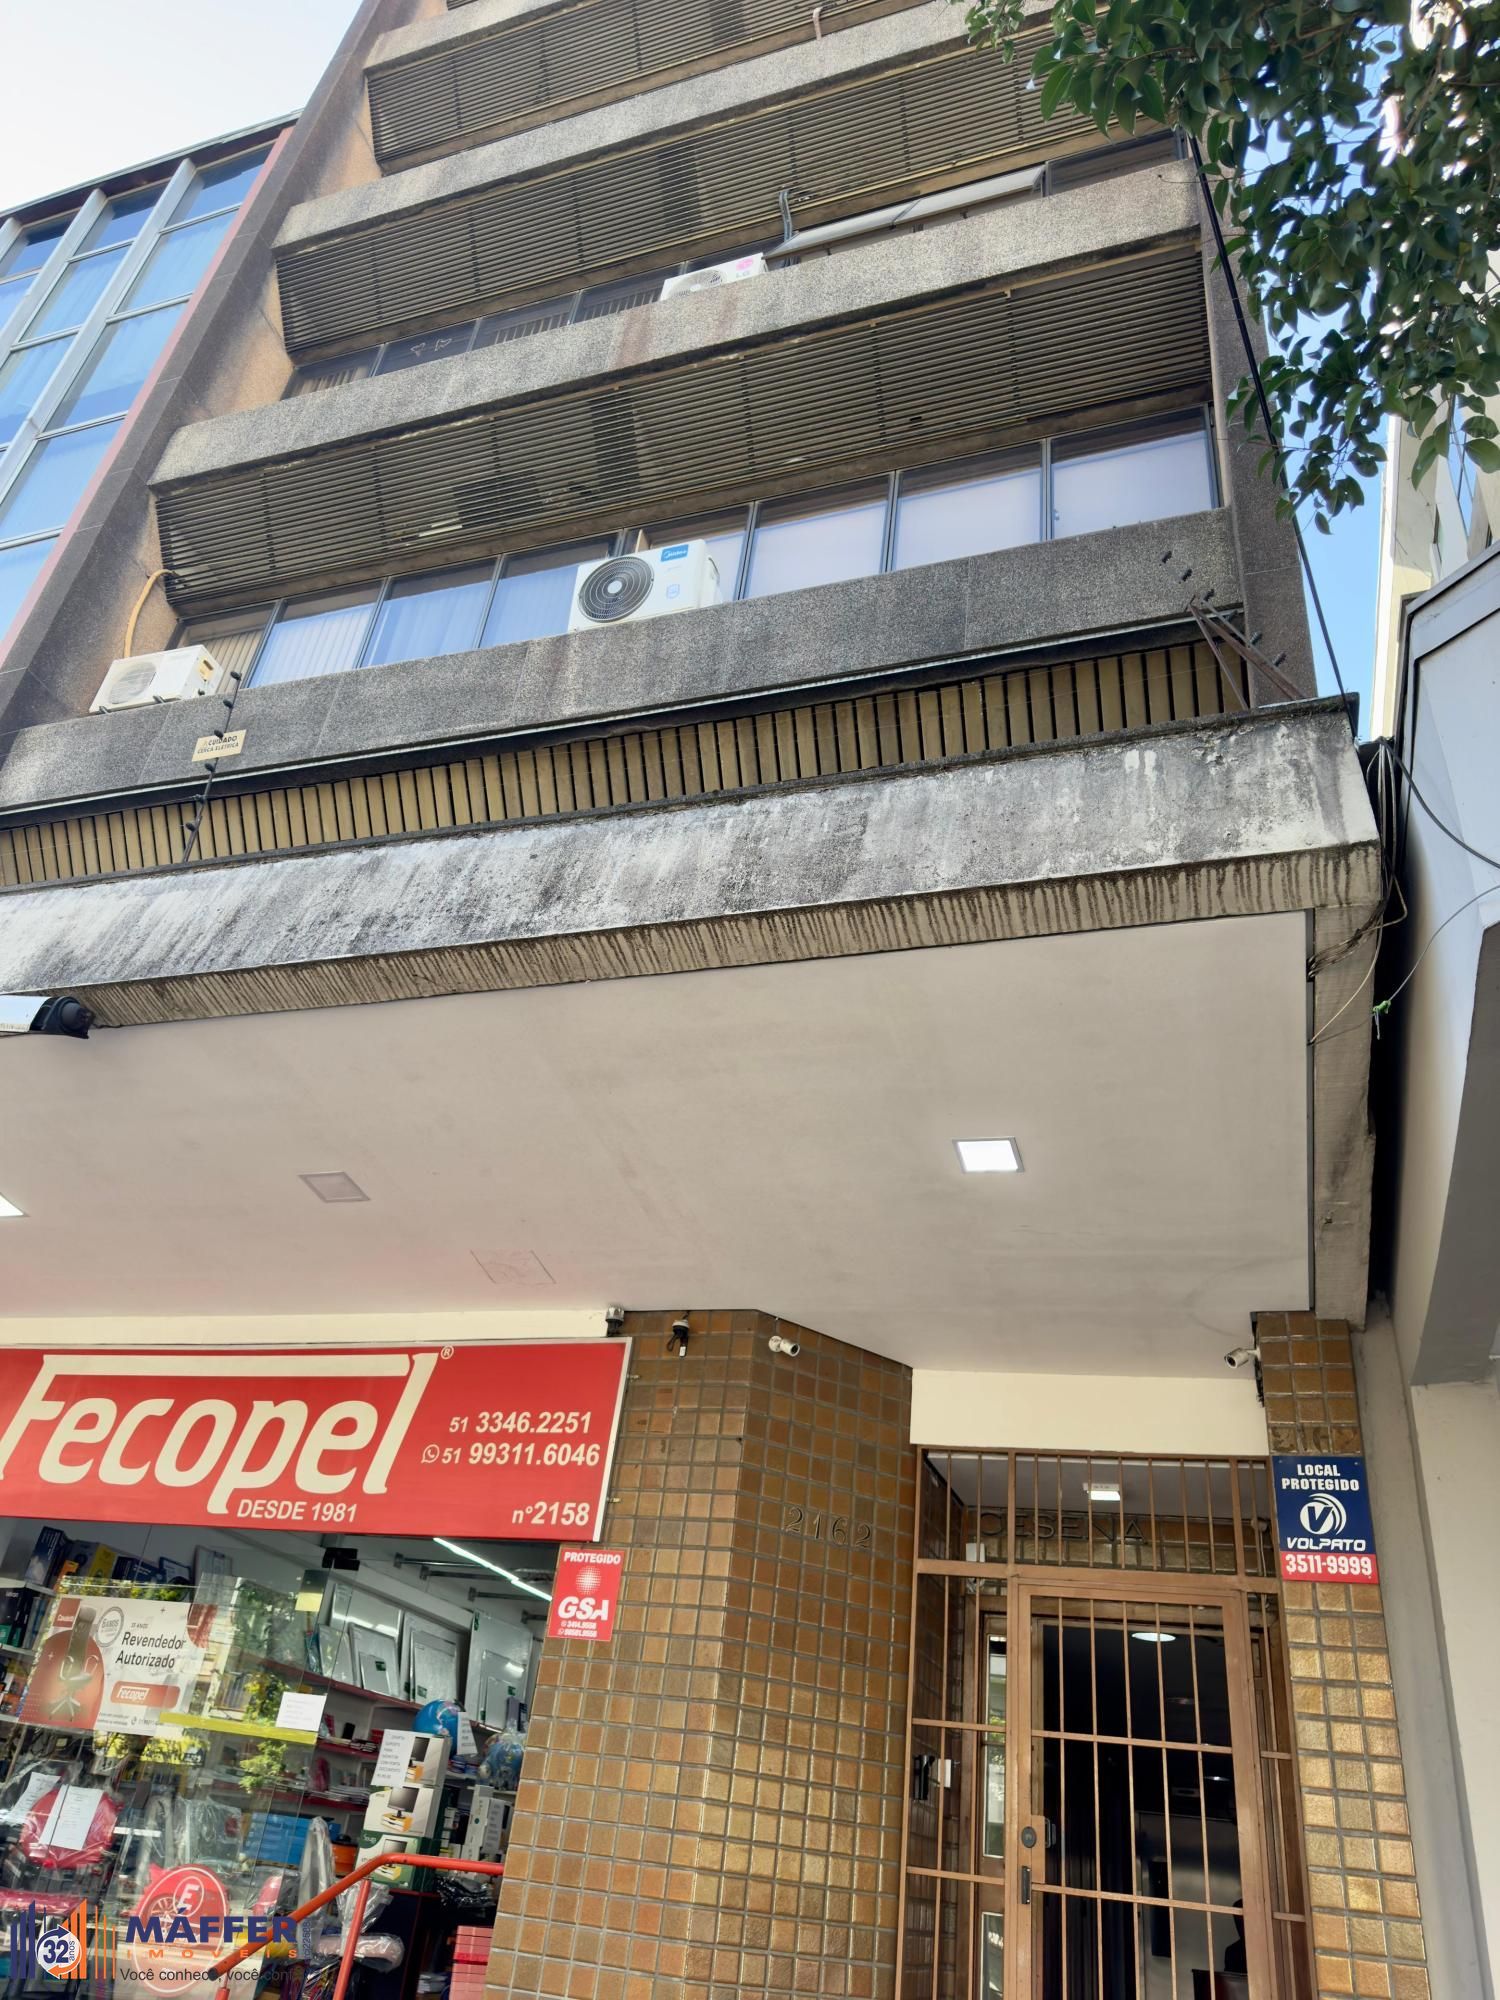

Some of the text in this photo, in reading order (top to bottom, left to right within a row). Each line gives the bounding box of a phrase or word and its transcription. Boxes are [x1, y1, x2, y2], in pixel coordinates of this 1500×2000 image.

[208, 736, 238, 746] CUIDADO
[449, 1411, 592, 1434] 51 3346.2251
[0, 1353, 439, 1514] Fecopel
[441, 1442, 600, 1466] 51 99311.6046
[1297, 1464, 1340, 1476] LOCAL
[1281, 1478, 1360, 1491] PROTEGIDO
[237, 1499, 357, 1523] DESDE 1981
[785, 1505, 871, 1549] 2162
[1286, 1537, 1366, 1551] VOLPATO
[563, 1551, 621, 1565] PROTEGIDO
[1285, 1554, 1372, 1575] 3511-9999
[558, 1596, 610, 1621] GSA
[121, 1631, 187, 1650] Revendedor
[115, 1650, 176, 1669] Autorizado
